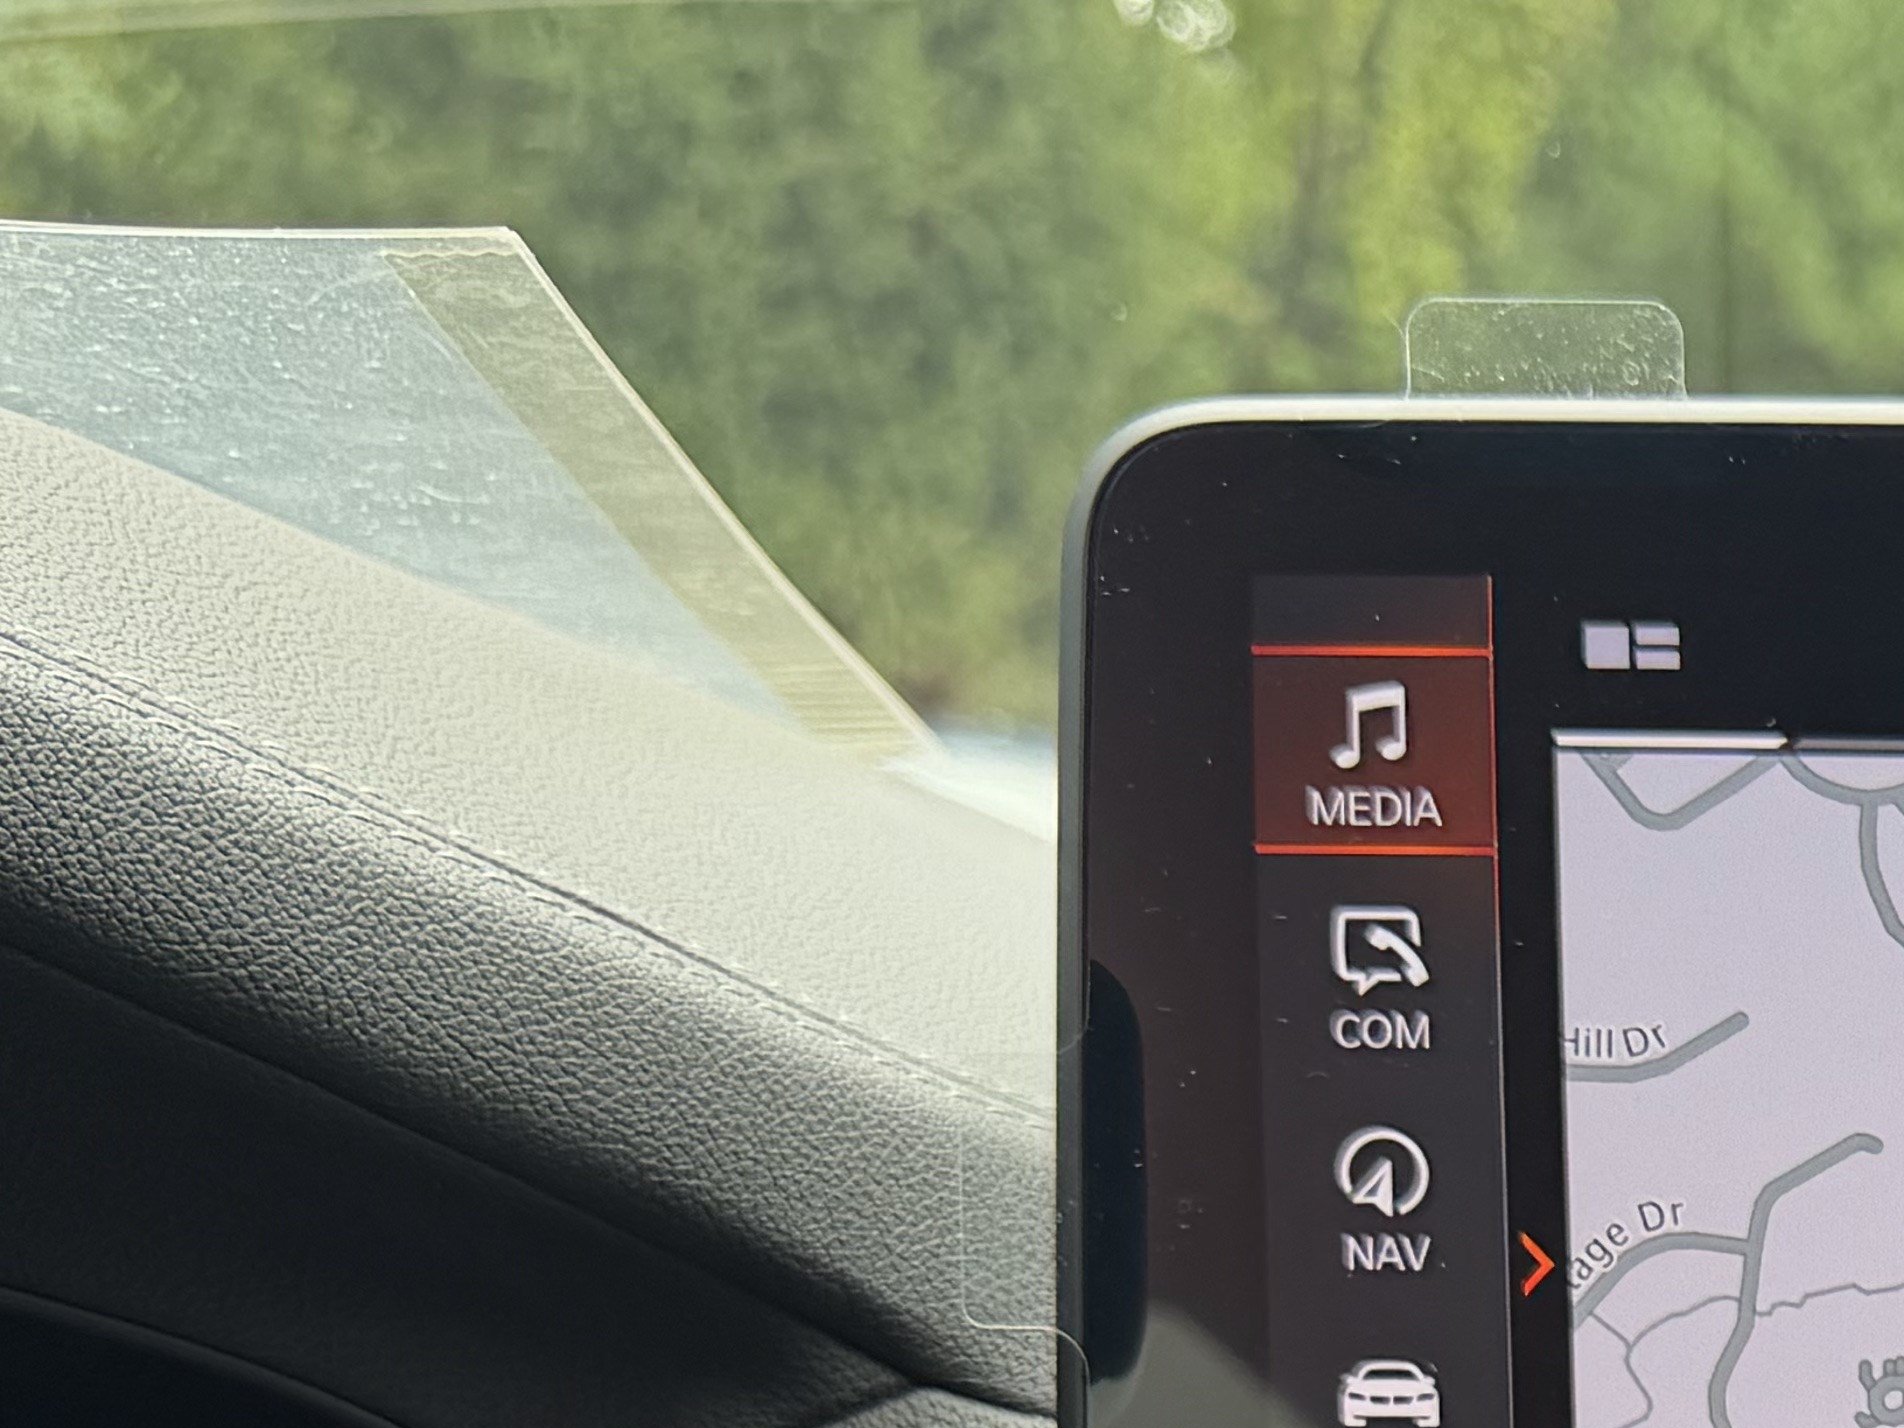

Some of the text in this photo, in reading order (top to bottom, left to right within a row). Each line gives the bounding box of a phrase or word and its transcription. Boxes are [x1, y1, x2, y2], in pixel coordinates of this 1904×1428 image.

[1305, 785, 1444, 828] MEDIA
[1330, 1008, 1432, 1052] COM
[1623, 1024, 1666, 1058] Dr
[1637, 1200, 1684, 1233] Dr
[1340, 1232, 1432, 1274] NAV
